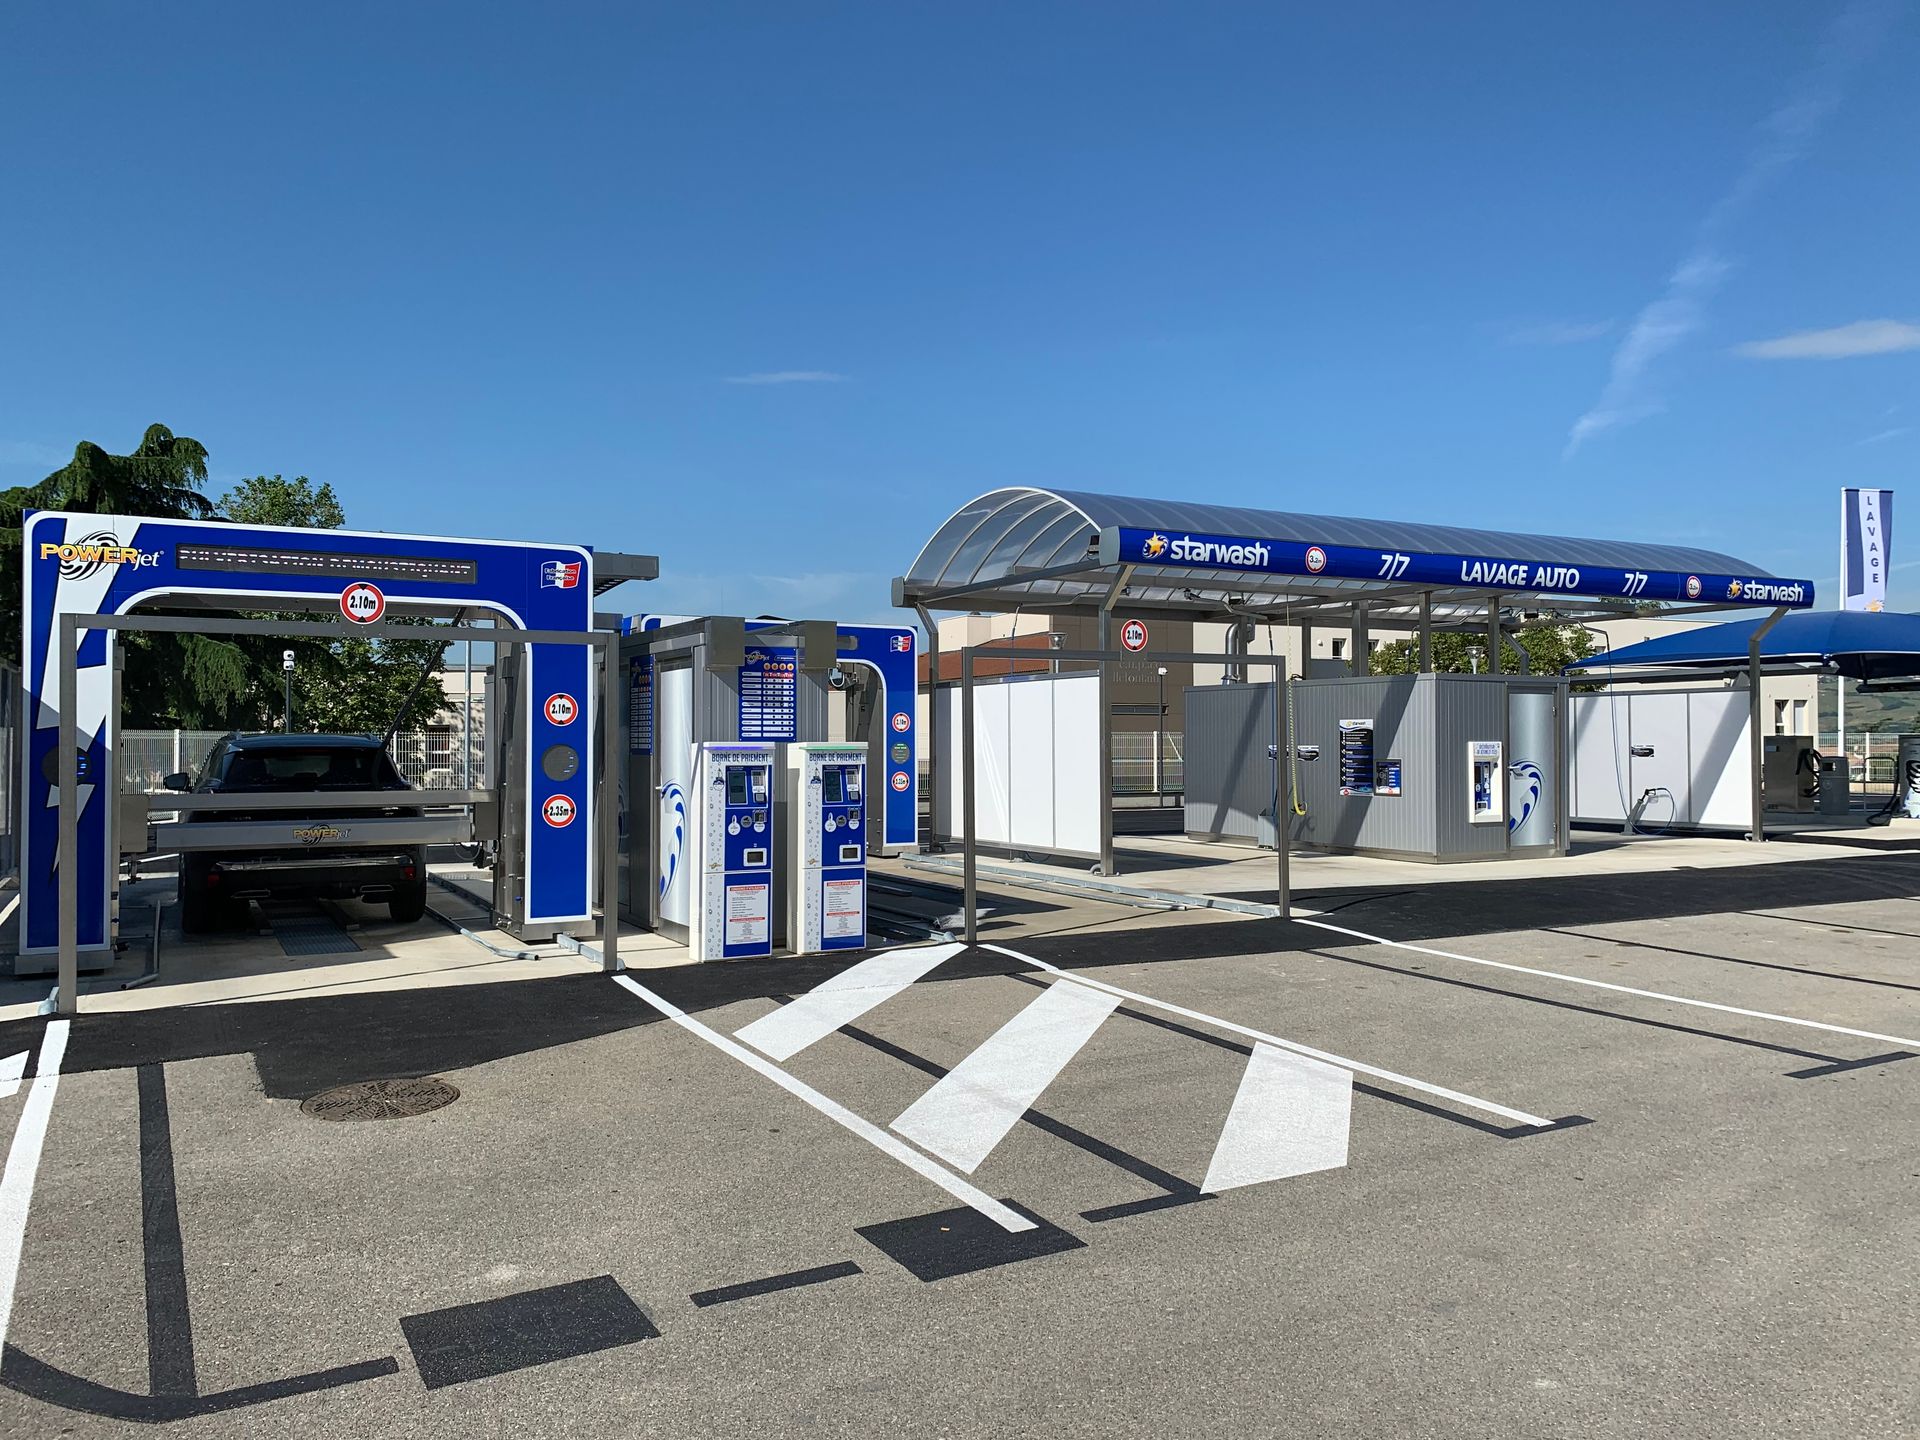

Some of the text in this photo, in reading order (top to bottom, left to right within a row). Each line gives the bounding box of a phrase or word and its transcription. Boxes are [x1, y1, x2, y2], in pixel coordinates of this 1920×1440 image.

[1866, 495, 1879, 583] LAVAGE
[1170, 535, 1270, 567] starwash
[1377, 552, 1410, 580] 7/7
[1460, 560, 1580, 589] LAVAGE AUTO
[1621, 571, 1648, 596] 7/7
[1743, 580, 1804, 602] starwash
[349, 595, 376, 610] 2.10m
[551, 703, 572, 714] 2.10m
[711, 753, 769, 763] BORNE DE PAIEMENT
[809, 752, 862, 762] BORNE DE PAIEMENT
[549, 805, 569, 816] 2.35m
